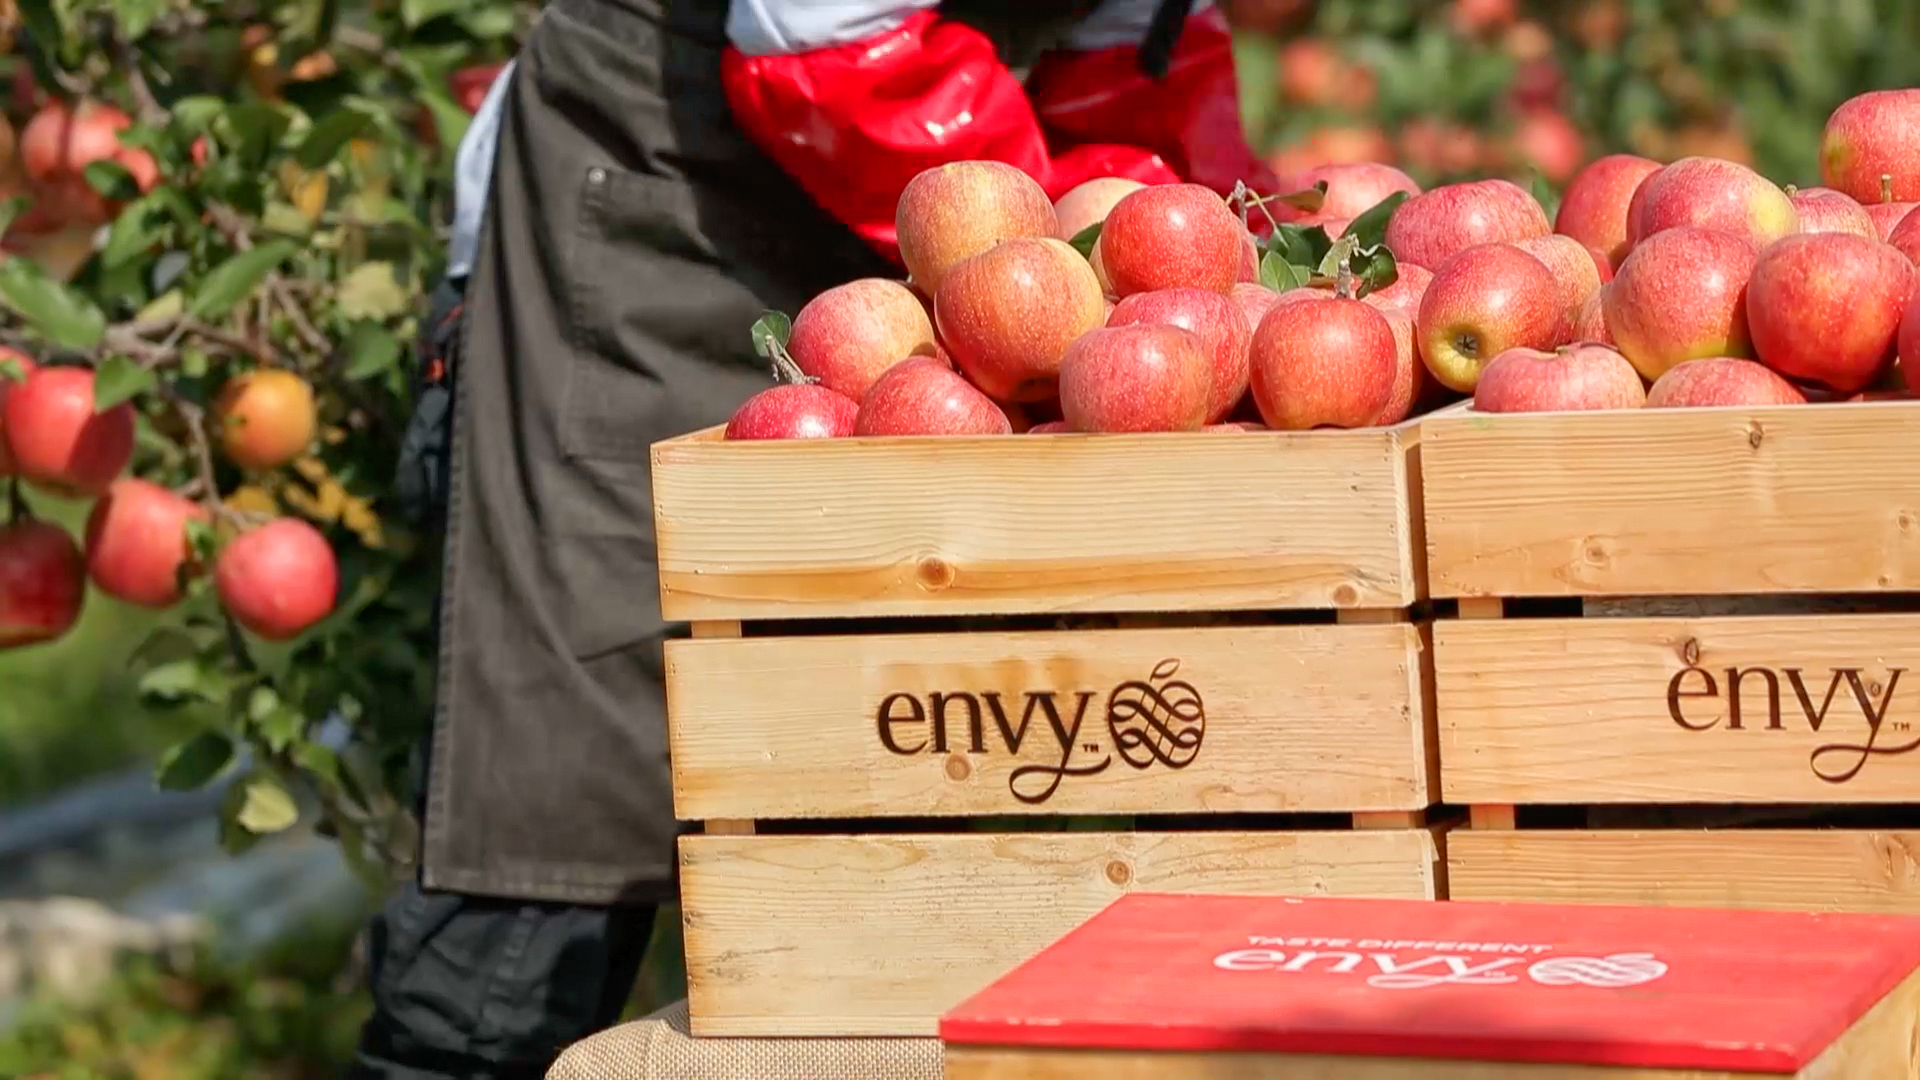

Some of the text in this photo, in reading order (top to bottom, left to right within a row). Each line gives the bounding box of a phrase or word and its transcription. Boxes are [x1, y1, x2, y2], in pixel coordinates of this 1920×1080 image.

[877, 690, 1111, 804] envy
[1667, 667, 1920, 783] envy
[1213, 949, 1527, 989] envy
[1247, 935, 1552, 954] TASTE DIFFERENT
